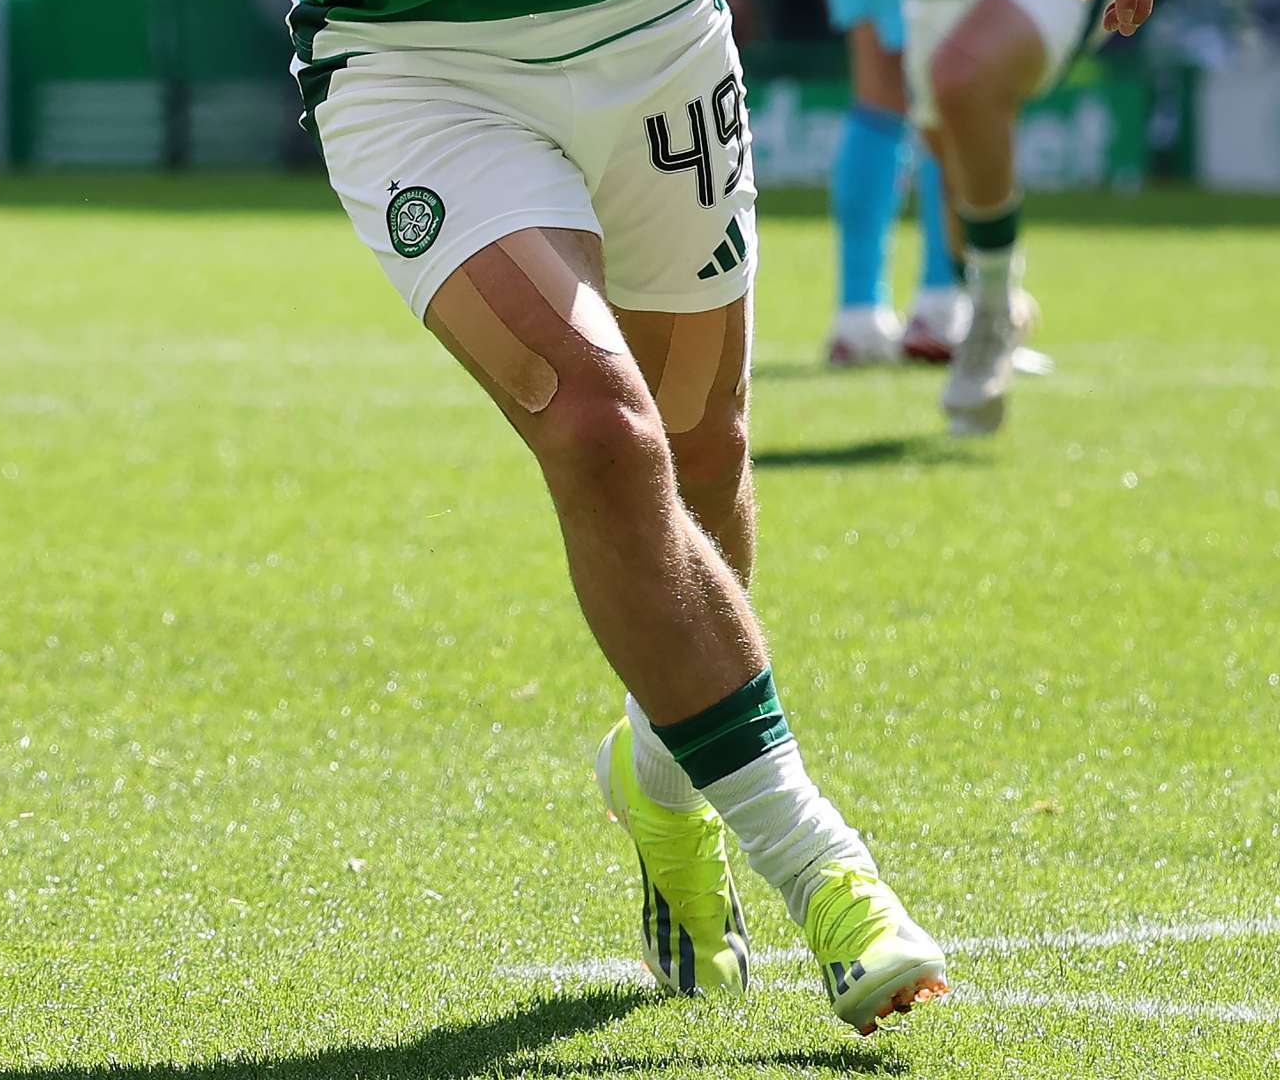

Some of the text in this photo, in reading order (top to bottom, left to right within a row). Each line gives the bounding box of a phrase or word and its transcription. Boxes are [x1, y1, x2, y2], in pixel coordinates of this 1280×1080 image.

[643, 71, 746, 210] 49
[390, 207, 398, 230] CELTIC
[394, 191, 422, 209] FOOTBALL
[422, 192, 437, 207] CLUB
